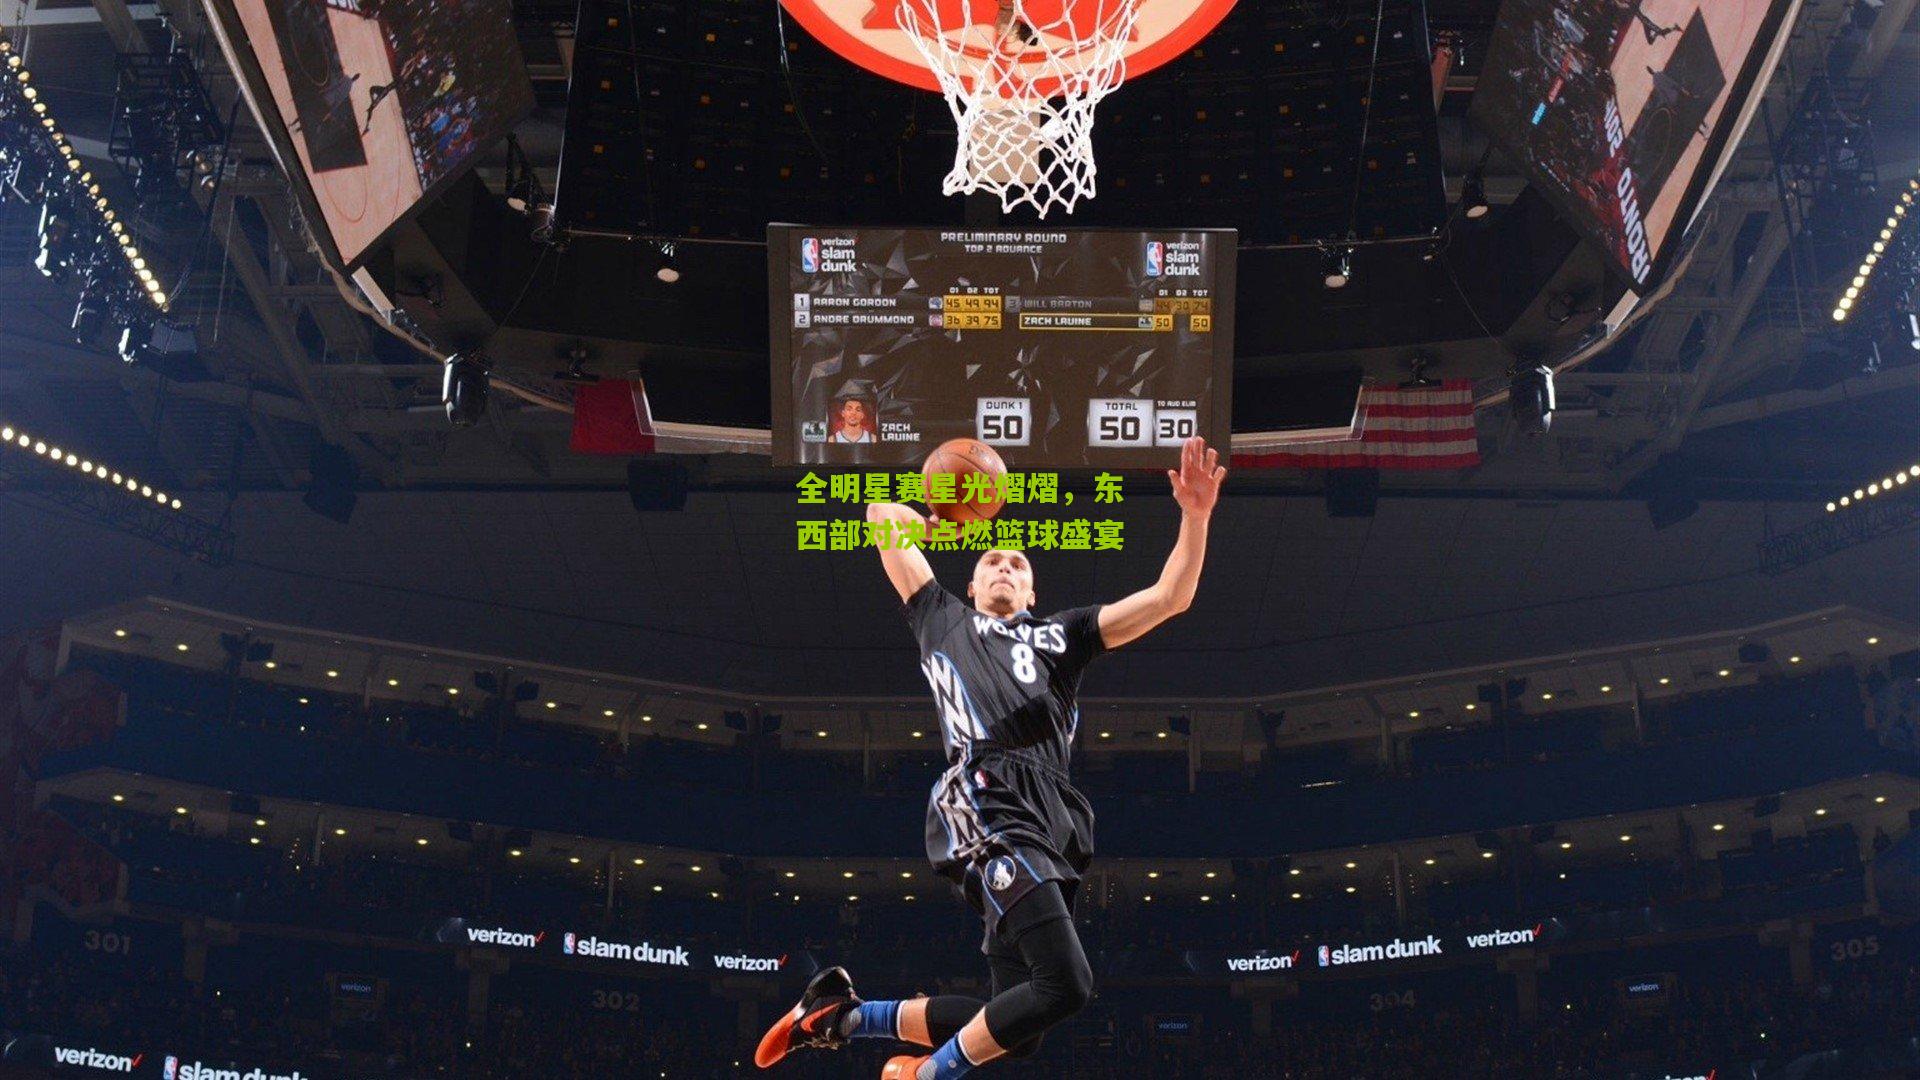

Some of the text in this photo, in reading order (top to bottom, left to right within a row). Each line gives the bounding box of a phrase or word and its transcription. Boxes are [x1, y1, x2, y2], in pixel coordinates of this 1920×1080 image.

[1617, 167, 1651, 285] RONTO
[821, 238, 855, 246] verizon
[940, 232, 1067, 243] PRELIMINARY ROUND
[964, 245, 984, 253] TOP
[986, 245, 993, 253] 2
[1165, 241, 1200, 250] verizon
[821, 247, 855, 259] slam
[1165, 251, 1199, 263] slam
[821, 259, 857, 272] dunk
[1165, 263, 1200, 276] dunk
[799, 297, 999, 308] 1 AARON GORDON 45 49 94
[1024, 300, 1047, 308] WILL
[1050, 300, 1092, 309] BARTON
[798, 315, 806, 324] 2
[813, 315, 850, 324] ANDRE
[852, 315, 915, 324] DRUMMOND
[965, 316, 980, 326] 39
[983, 315, 999, 326] 75
[1024, 317, 1052, 325] ZACH
[1156, 317, 1170, 328] 50
[1193, 317, 1208, 328] 50
[985, 401, 1015, 410] DUNK
[1105, 402, 1138, 411] TOTAL
[881, 423, 911, 432] ZACH
[983, 415, 1023, 440] 50
[1100, 416, 1140, 441] 50
[1159, 418, 1193, 439] 30
[973, 615, 1067, 654] WOLVES
[1011, 643, 1037, 684] 8
[84, 929, 132, 957] 301
[467, 927, 536, 948] verizon
[1466, 929, 1534, 949] verizon
[577, 936, 690, 966] slam dunk
[1331, 934, 1443, 966] slam dunk
[1829, 935, 1880, 963] 305
[714, 953, 779, 972] verizon
[1228, 954, 1292, 972] verizon
[340, 981, 372, 993] verizon
[1629, 982, 1660, 992] verizon
[592, 989, 641, 1012] 302
[54, 1046, 132, 1072] verizon
